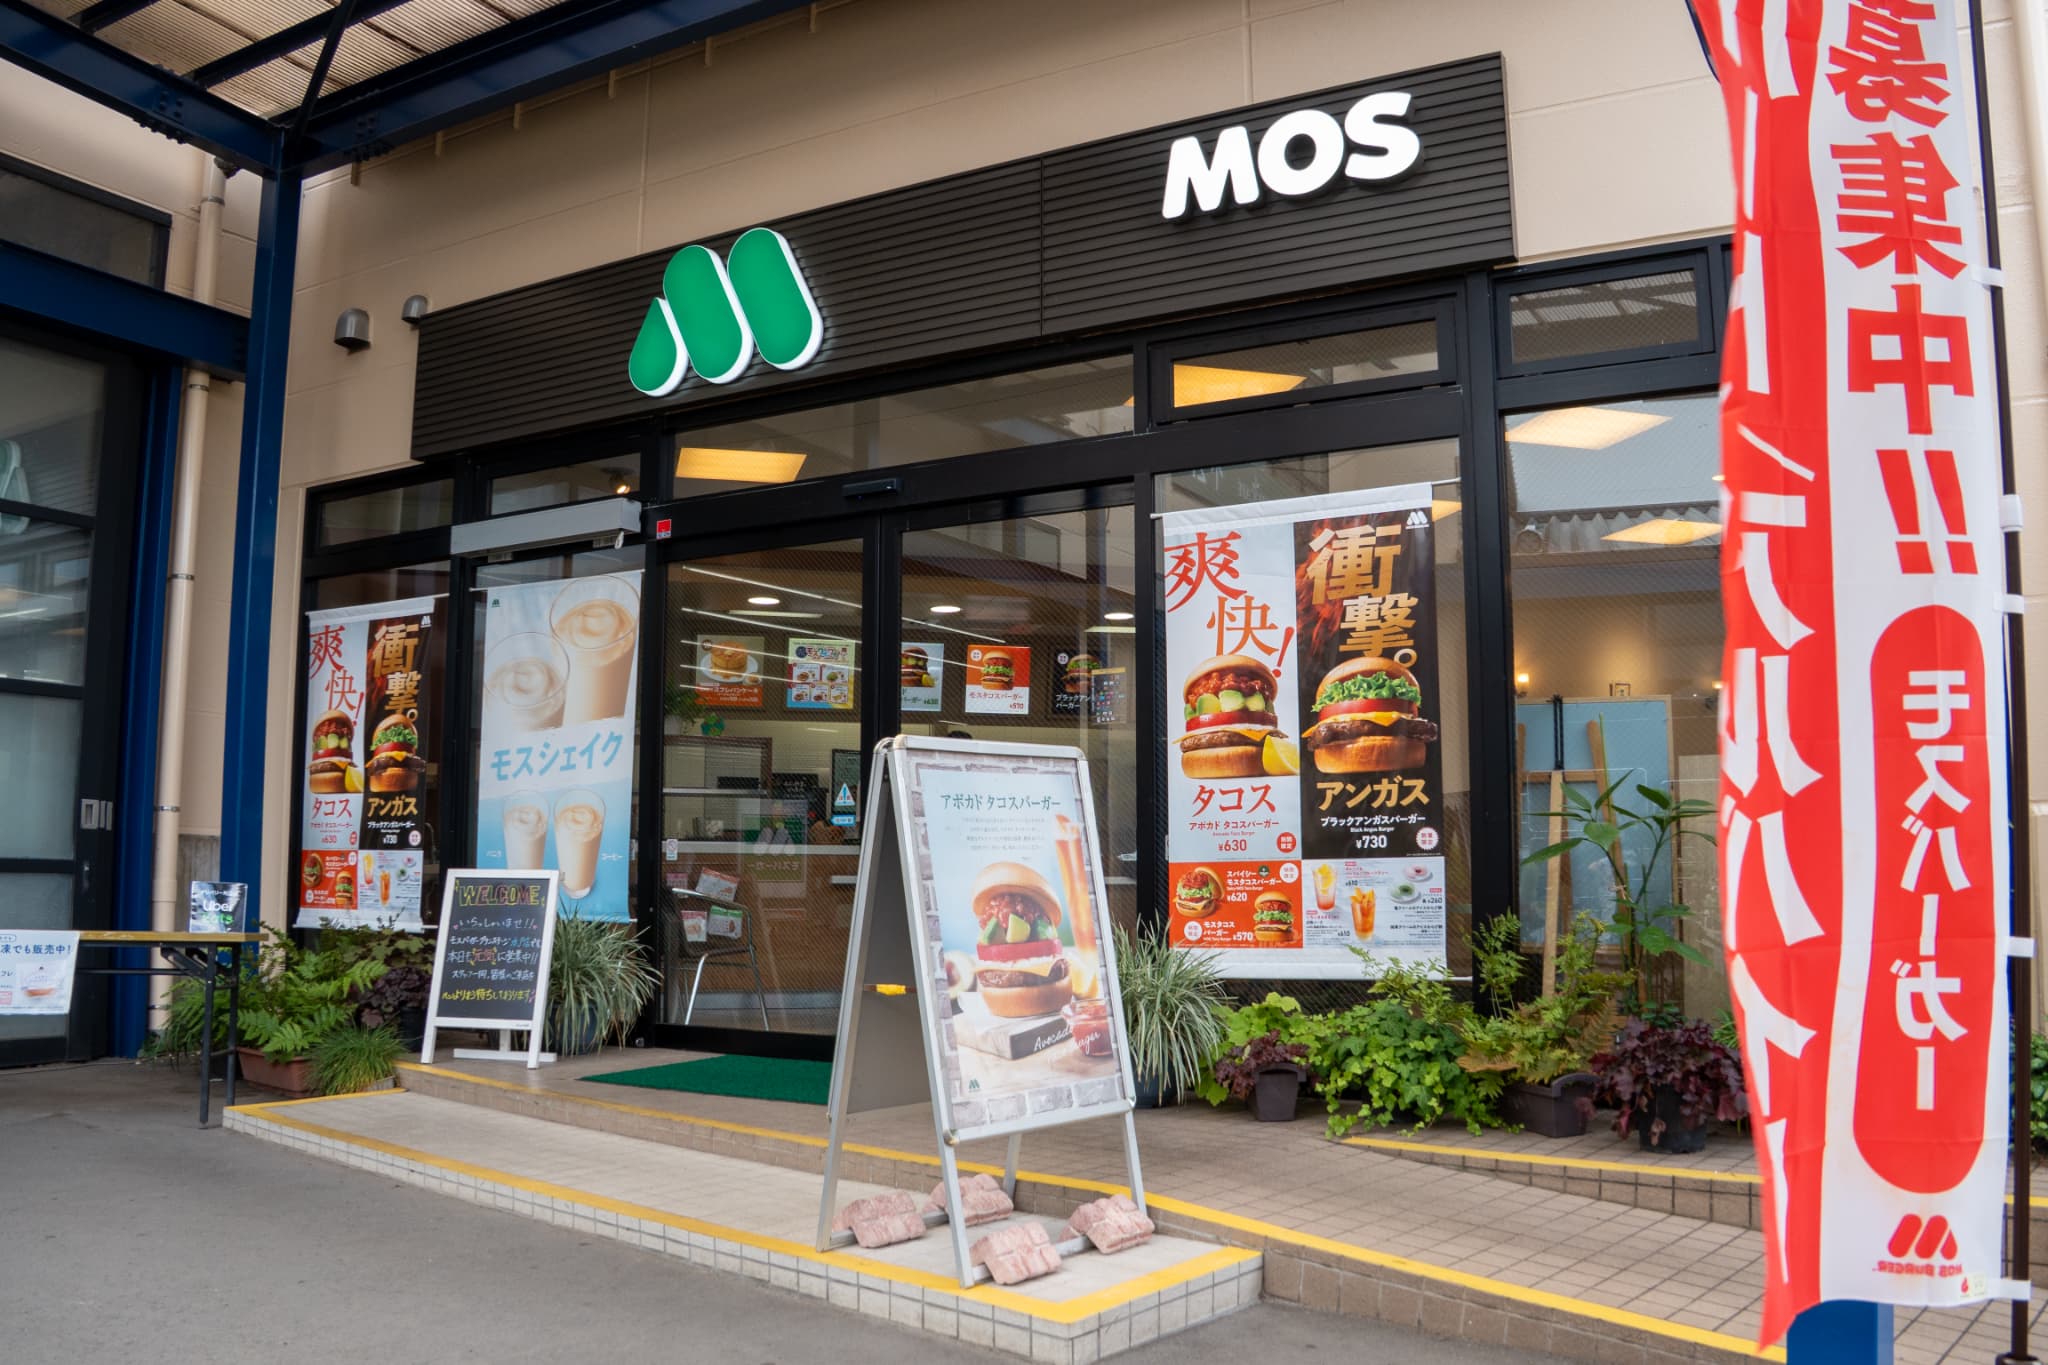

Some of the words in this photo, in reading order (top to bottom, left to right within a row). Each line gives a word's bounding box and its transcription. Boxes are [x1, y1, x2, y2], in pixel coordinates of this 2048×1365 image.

[1162, 92, 1420, 219] MOS
[969, 691, 1024, 699] モスタコスバーガー
[490, 731, 624, 780] モスシェイク
[1192, 784, 1276, 817] タコス
[1316, 776, 1430, 811] アンガス
[311, 797, 352, 819] タコス
[368, 795, 418, 817] アンガス
[940, 793, 983, 810] アボカド
[987, 795, 1061, 810] タコスバーガー
[1189, 821, 1219, 831] アボカド
[1223, 819, 1280, 830] タコスバーガー
[1321, 813, 1426, 827] ブラックアンガスバーガー
[1218, 839, 1247, 852] ¥630
[1356, 835, 1388, 848] ¥730
[459, 885, 541, 906] WELCOME
[1227, 892, 1248, 902] ¥620
[203, 899, 233, 912] Uber
[1203, 929, 1229, 937] バーガー
[1233, 931, 1254, 941] ¥570
